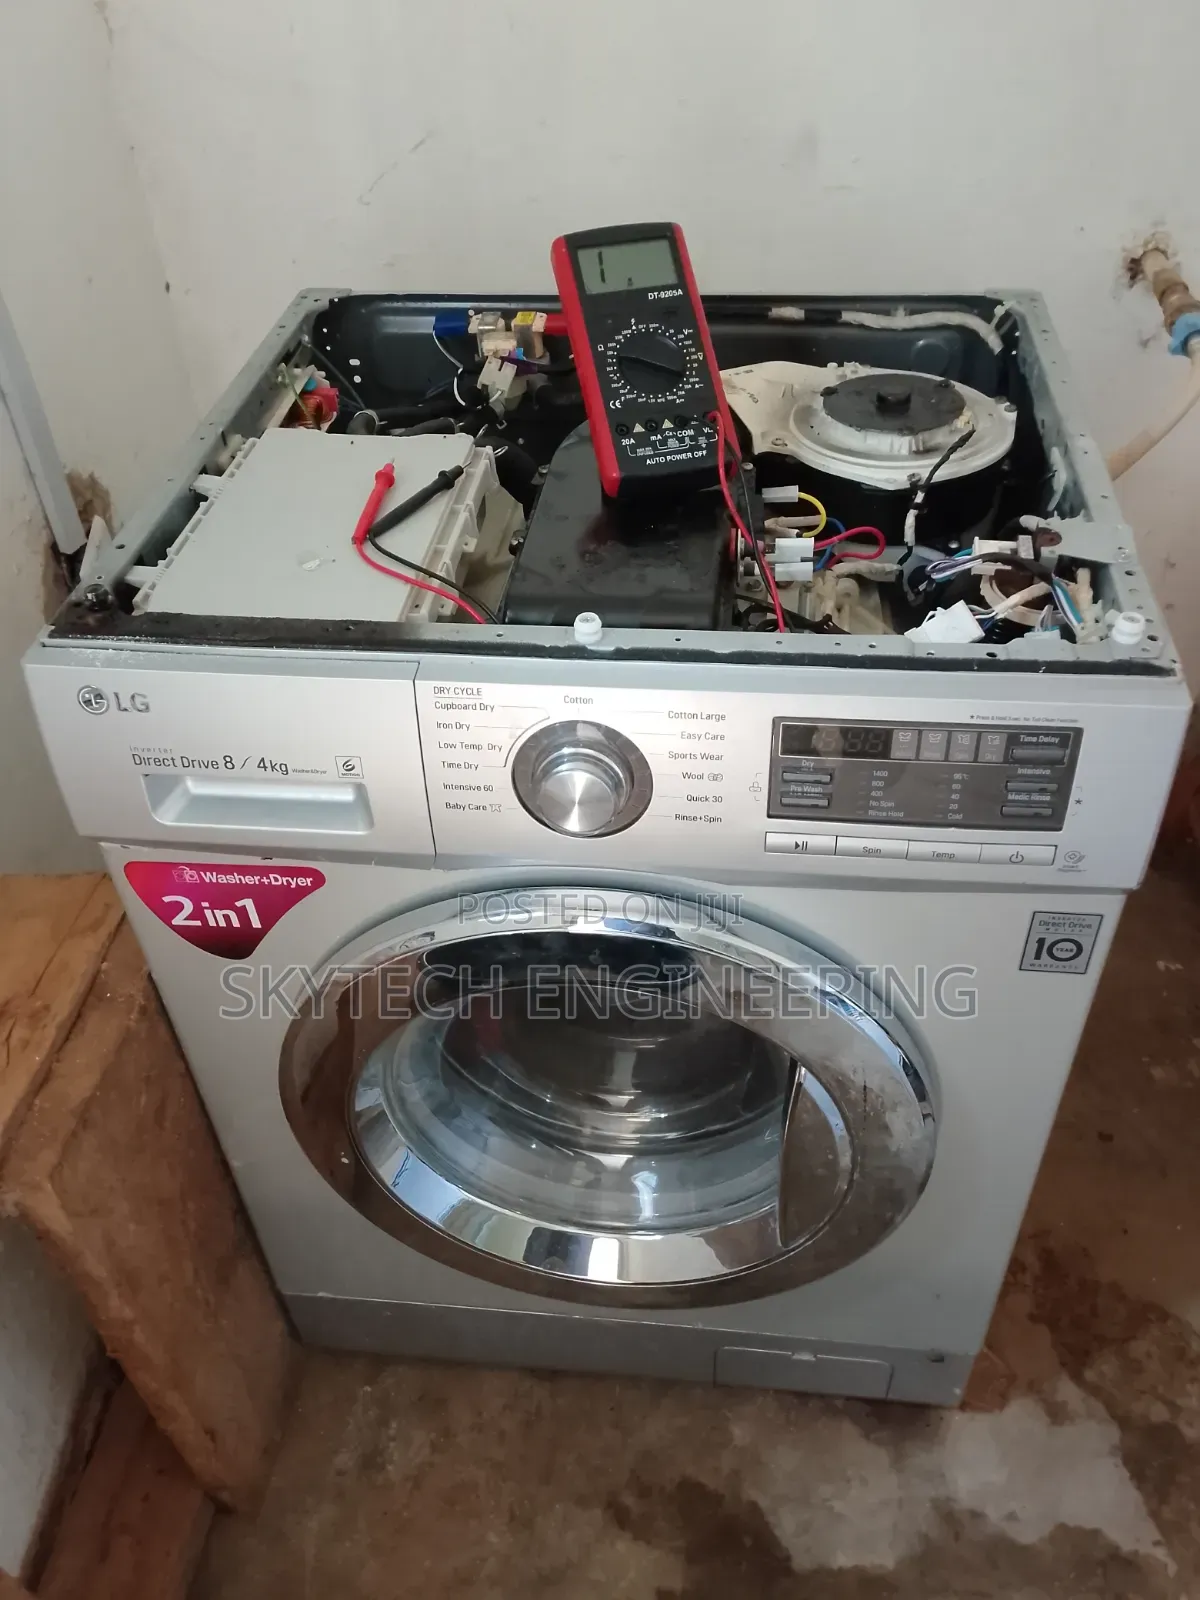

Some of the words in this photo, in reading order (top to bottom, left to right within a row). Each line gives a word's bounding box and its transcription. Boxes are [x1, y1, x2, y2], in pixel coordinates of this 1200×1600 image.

[648, 289, 684, 300] DT-9205A
[677, 429, 695, 437] COM
[621, 438, 636, 446] 20A
[646, 457, 666, 465] AUTO
[667, 453, 693, 462] POWER
[694, 450, 708, 458] OFF
[433, 686, 451, 695] DRY
[453, 687, 482, 696] CYCLE
[113, 691, 151, 713] LG
[563, 695, 594, 705] Cotton
[434, 701, 477, 711] Cupboard
[479, 702, 495, 712] Dry
[668, 710, 698, 720] Cotton
[700, 711, 726, 722] Large
[436, 721, 453, 730] Iron
[455, 722, 471, 731] Dry
[680, 731, 702, 741] Easy
[704, 732, 725, 741] Care
[1039, 735, 1060, 744] Delay
[438, 741, 457, 749] Low
[460, 742, 483, 751] Temp
[487, 743, 503, 752] Dry
[668, 751, 698, 760] Sports
[700, 752, 724, 761] Wear
[132, 753, 177, 768] Direct
[180, 756, 219, 769] Drive
[223, 755, 235, 770] 8
[441, 761, 462, 769] Time
[464, 762, 479, 771] Dry
[682, 772, 704, 780] Wool
[443, 782, 482, 792] Intensive
[803, 785, 823, 793] Wash
[686, 794, 710, 803] Quick
[711, 795, 723, 803] 30
[445, 802, 466, 811] Baby
[468, 803, 488, 811] Care
[675, 813, 722, 823] Rinse+Spin
[862, 846, 882, 855] Spin
[931, 851, 955, 860] Temp
[200, 871, 313, 889] Washer+Dryer
[1038, 919, 1066, 928] Direct
[1068, 921, 1092, 930] Drive
[1033, 937, 1084, 962] 10
